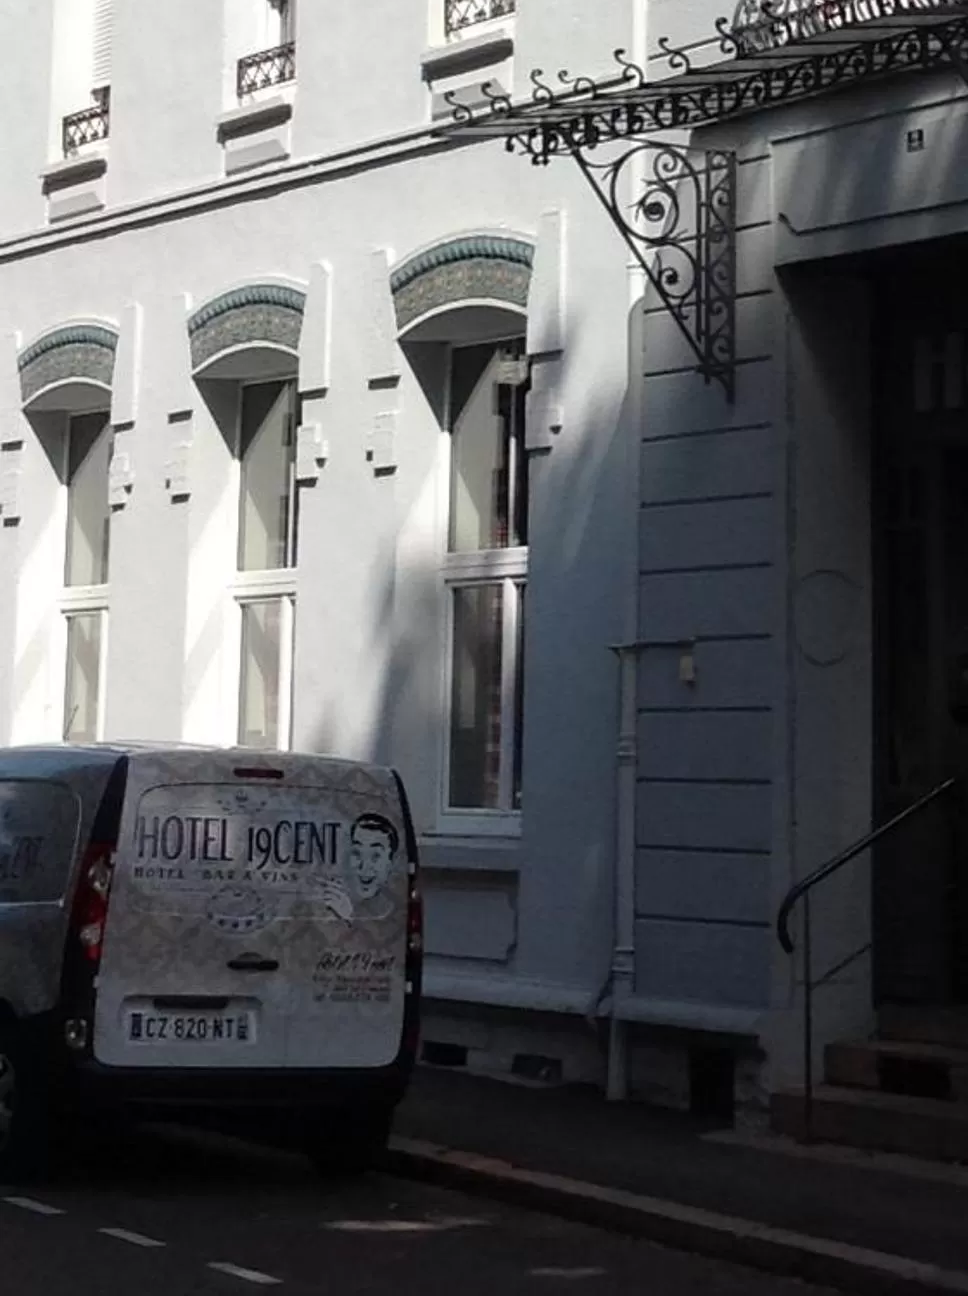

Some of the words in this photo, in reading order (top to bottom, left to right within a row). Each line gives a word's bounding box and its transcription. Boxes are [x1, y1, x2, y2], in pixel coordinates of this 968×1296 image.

[138, 815, 233, 862] HOTEL
[248, 821, 341, 870] 19CENT
[134, 867, 185, 880] HOTEL
